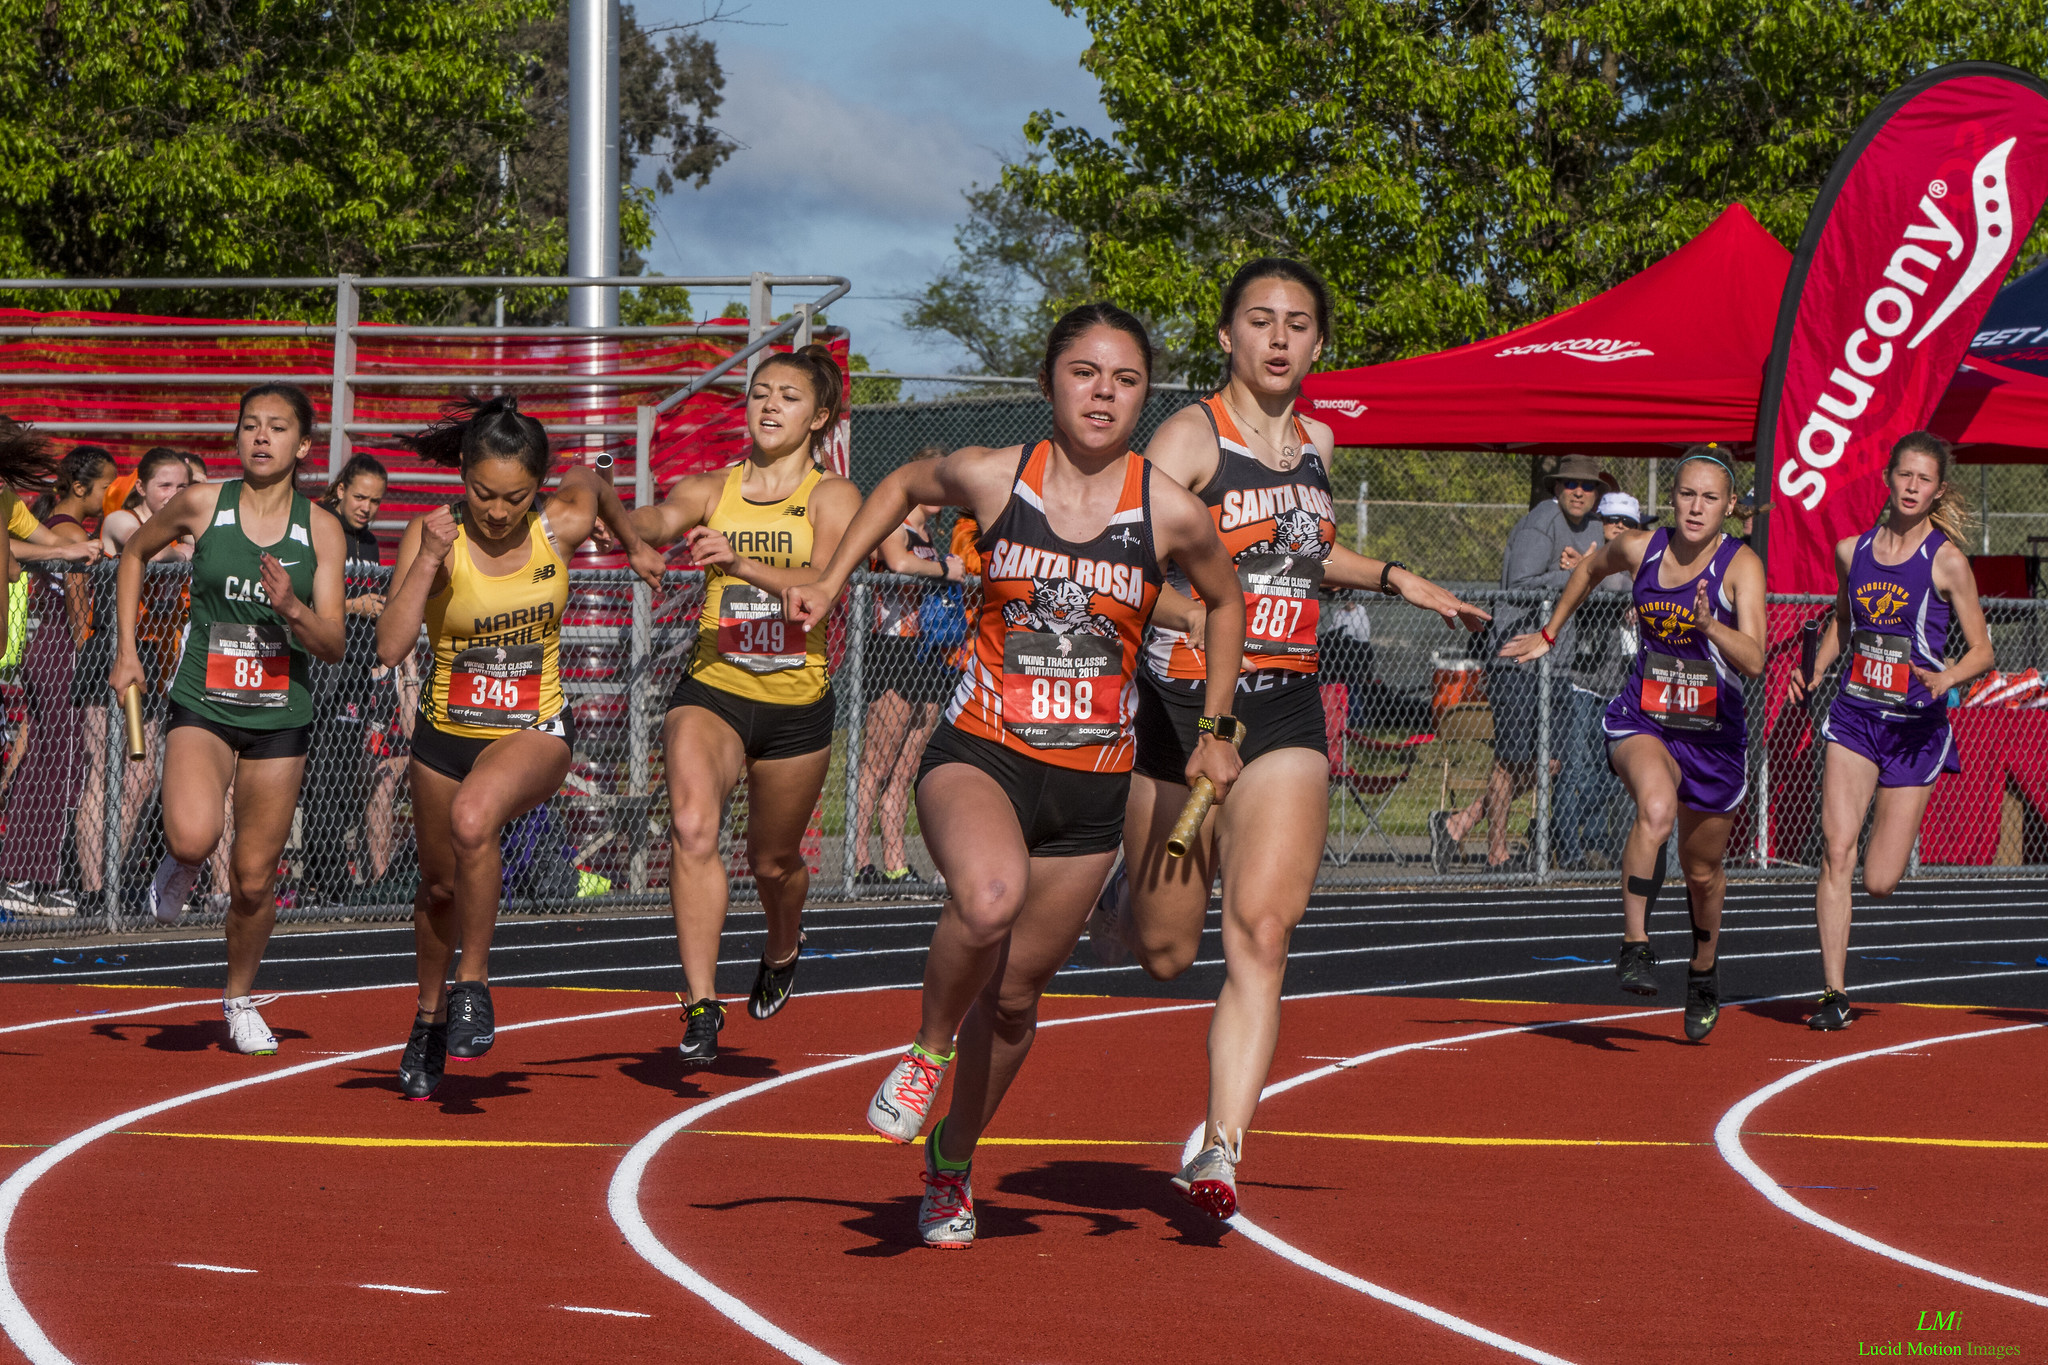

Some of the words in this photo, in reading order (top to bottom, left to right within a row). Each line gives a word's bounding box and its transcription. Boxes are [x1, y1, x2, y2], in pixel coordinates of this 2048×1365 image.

[1222, 484, 1294, 530] SANTA
[1296, 484, 1336, 524] ROS
[723, 531, 792, 553] MARIA
[990, 538, 1070, 580] SANTA
[1075, 558, 1144, 610] ROSA
[1248, 573, 1272, 584] VIKING
[1272, 575, 1290, 586] TRACK
[1291, 577, 1311, 589] CLASSIC
[225, 576, 272, 605] CAS
[1254, 585, 1292, 597] INVITATIONAL
[1856, 581, 1910, 600] MIDDLETOWN
[474, 602, 554, 634] MARIA
[730, 602, 749, 611] VIKING
[750, 602, 770, 611] TRACK
[1251, 597, 1302, 638] 887
[1639, 601, 1695, 622] MIDDLETOWN
[219, 639, 238, 648] VIKING
[739, 621, 785, 653] 349
[234, 658, 263, 688] 83
[464, 661, 485, 669] VIKING
[486, 662, 507, 671] TRACK
[508, 661, 533, 671] CLASSIC
[1018, 655, 1045, 666] VIKING
[1047, 656, 1073, 668] TRACK
[1075, 656, 1108, 667] CLASSIC
[1025, 665, 1077, 678] INVITATIONAL
[1078, 667, 1100, 678] 2019
[1863, 660, 1892, 688] 448
[471, 675, 519, 708] 345
[1032, 678, 1093, 719] 898
[1659, 684, 1699, 712] 440
